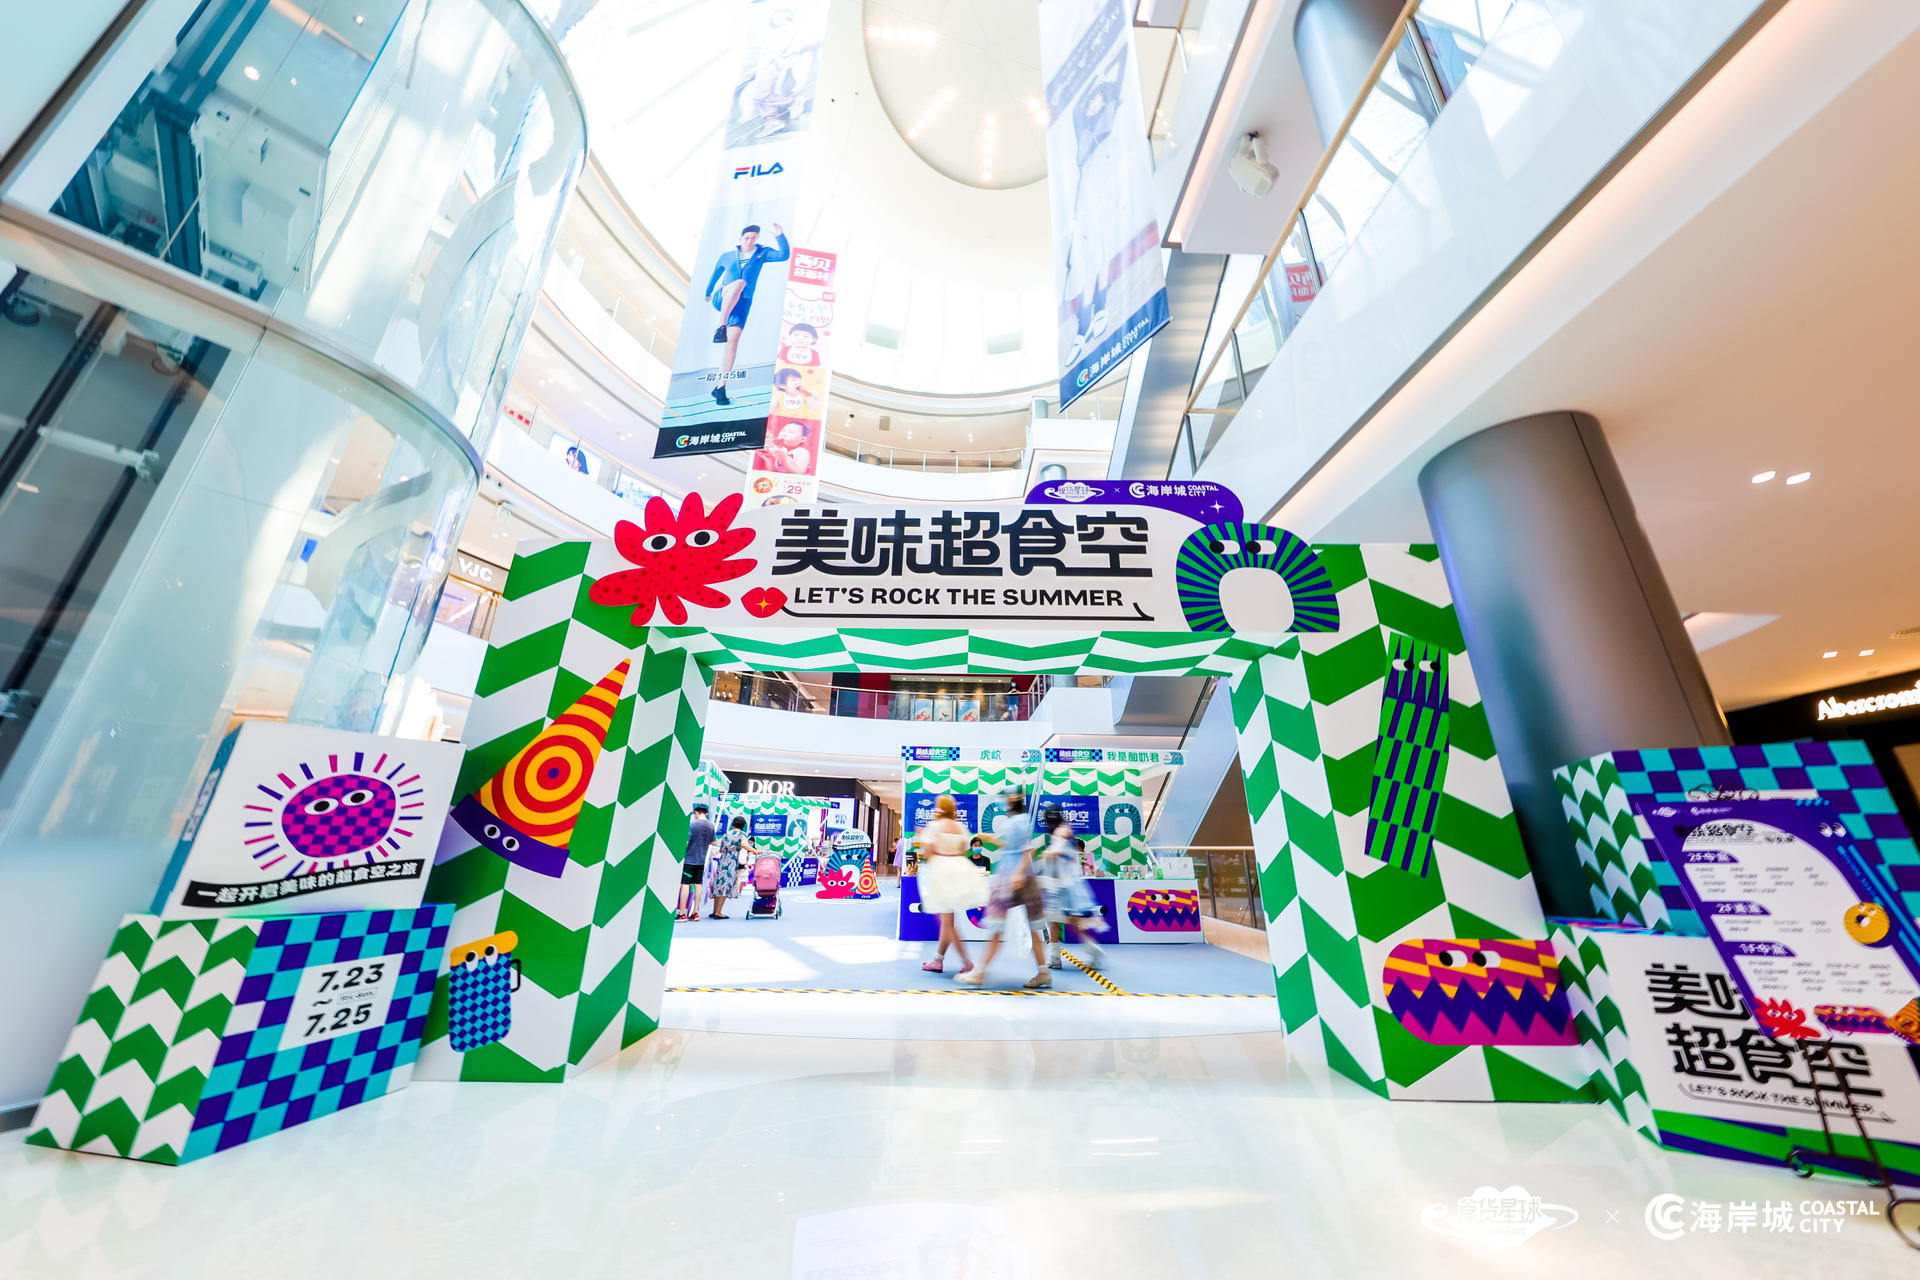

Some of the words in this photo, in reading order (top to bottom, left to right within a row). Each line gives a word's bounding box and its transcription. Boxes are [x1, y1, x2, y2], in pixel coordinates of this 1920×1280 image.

[734, 162, 784, 179] FILA
[689, 433, 721, 447] 海岸城
[1146, 485, 1187, 497] 海岸城
[772, 508, 1153, 578] 美味超食空
[458, 557, 493, 582] VJC
[794, 587, 864, 604] LET'S
[871, 588, 940, 605] ROCK
[947, 588, 996, 605] THE
[1002, 588, 1123, 606] SUMMER
[1107, 752, 1159, 763] 我是酸奶君
[748, 779, 795, 795] DIOR
[318, 963, 384, 993] 7.23
[303, 1003, 373, 1037] 7.25
